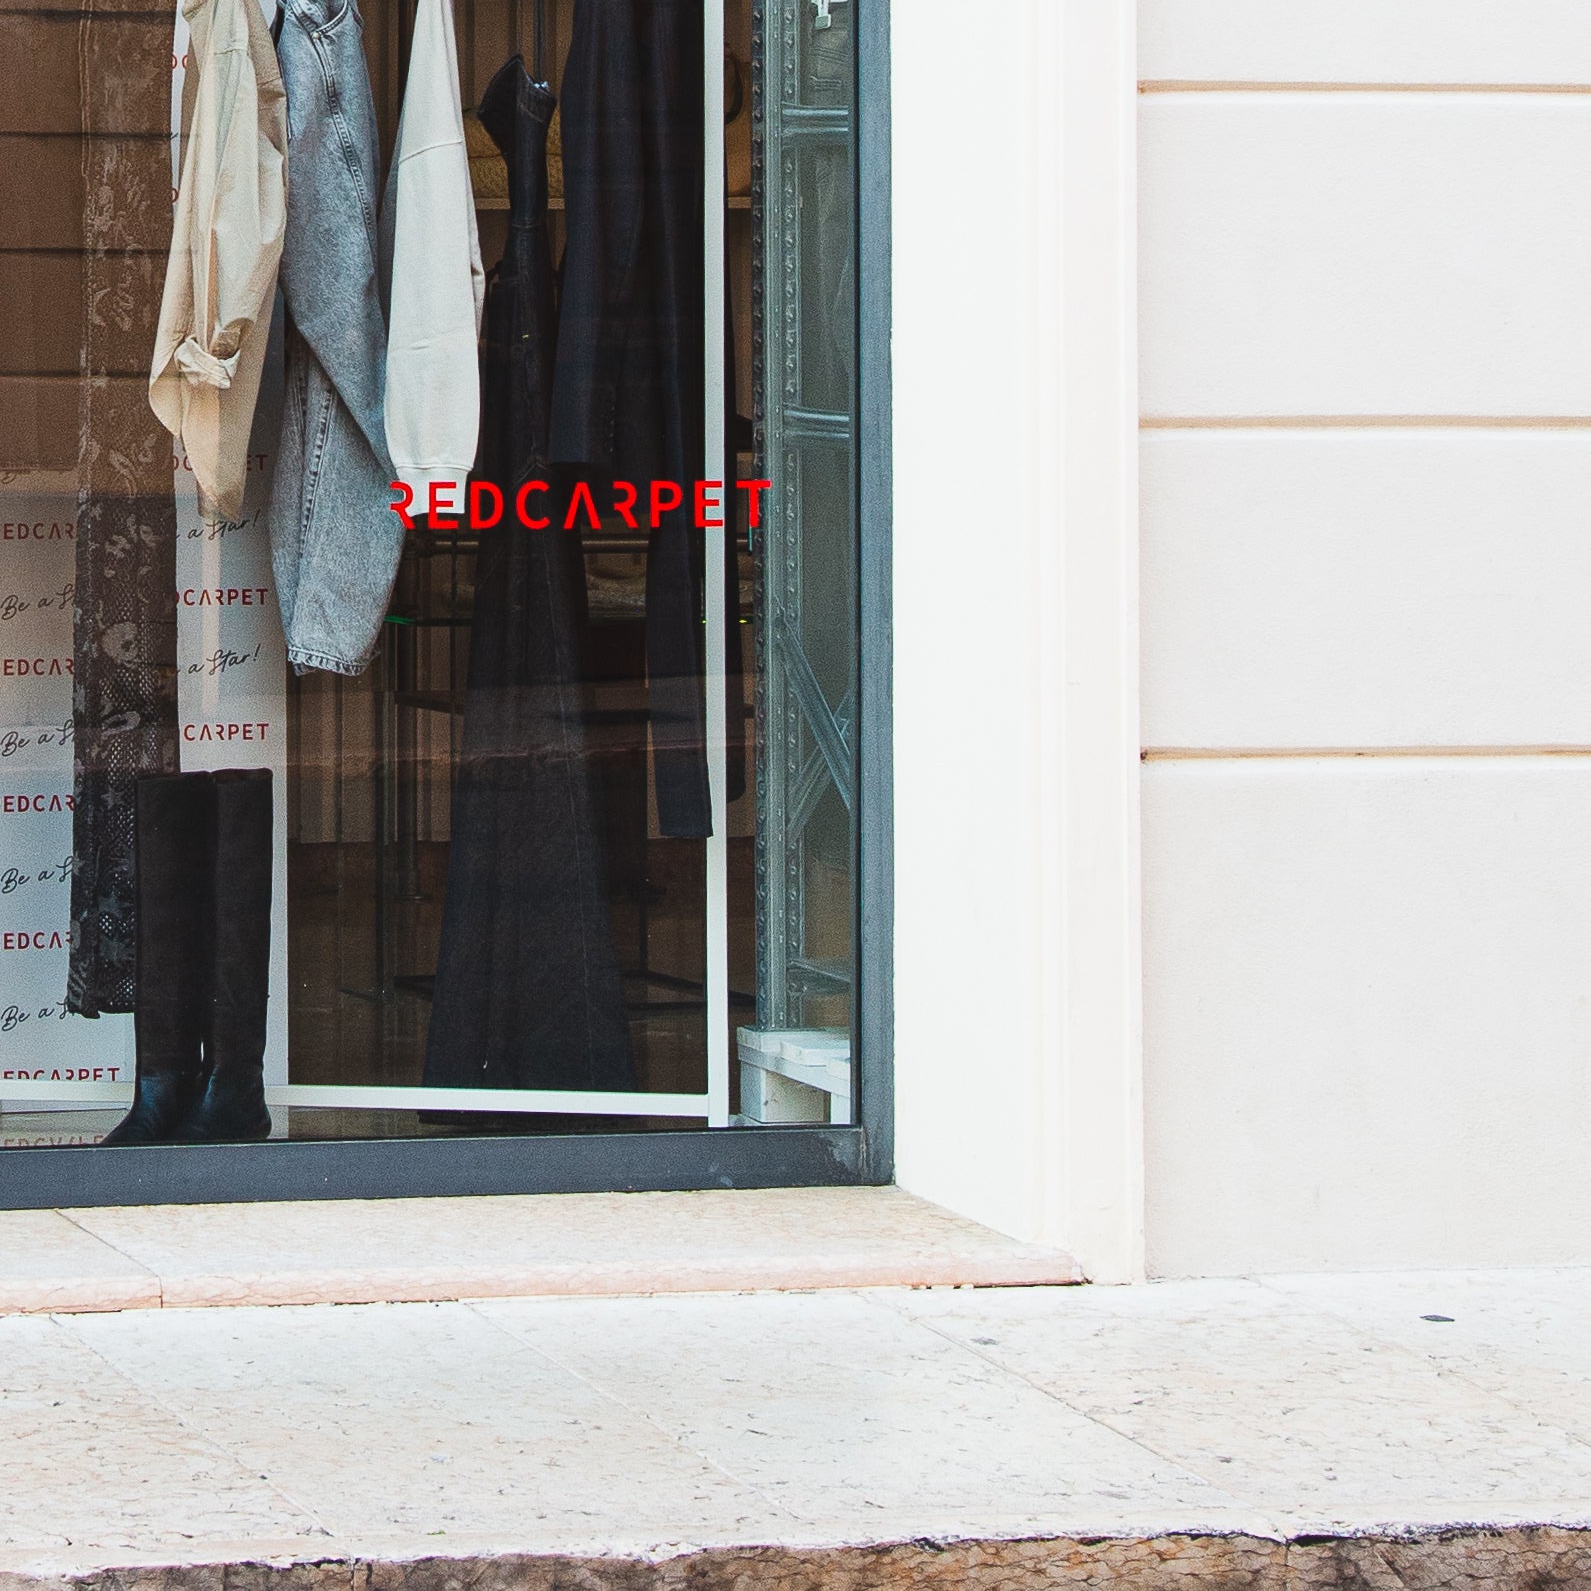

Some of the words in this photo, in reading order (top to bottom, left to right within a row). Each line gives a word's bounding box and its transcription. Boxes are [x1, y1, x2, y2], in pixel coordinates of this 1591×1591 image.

[388, 479, 772, 530] REDCARPET
[188, 528, 204, 539] a
[1, 594, 30, 621] Be
[37, 597, 54, 608] a
[174, 588, 268, 606] CARPET
[188, 663, 205, 675] a
[206, 643, 261, 676] Star!
[1, 731, 30, 757] Be
[37, 732, 54, 744] a
[183, 722, 270, 741] CARPET
[1, 867, 30, 894] Be
[37, 870, 54, 881] a
[1, 1005, 30, 1032] Be
[37, 1007, 55, 1018] a
